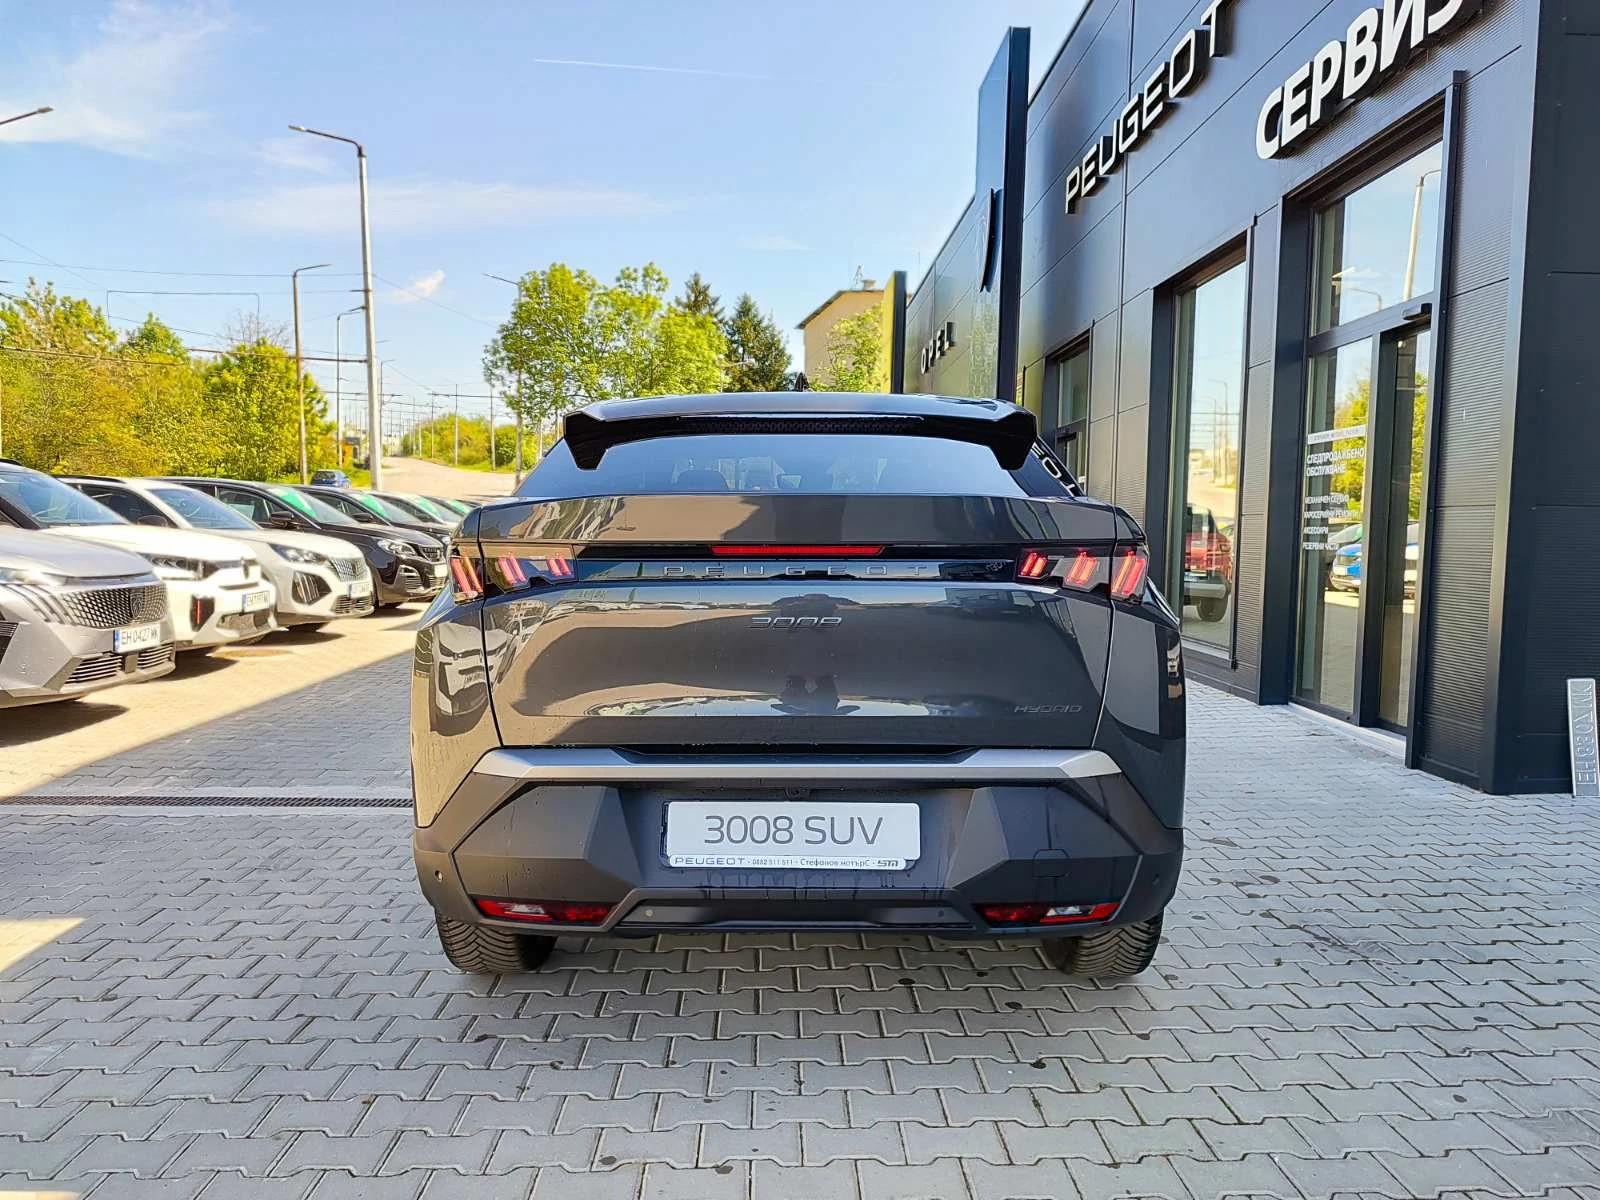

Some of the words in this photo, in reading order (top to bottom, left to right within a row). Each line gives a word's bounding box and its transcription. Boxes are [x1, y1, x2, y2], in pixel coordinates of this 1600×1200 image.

[1065, 0, 1222, 214] PEUGEOT
[920, 321, 950, 375] OPEL
[663, 565, 928, 577] PEUGEOT
[750, 617, 842, 628] 3008
[1014, 704, 1083, 713] HYBRID
[704, 815, 794, 844] 3008
[804, 816, 883, 844] SUV
[674, 857, 745, 865] PEUGEOT
